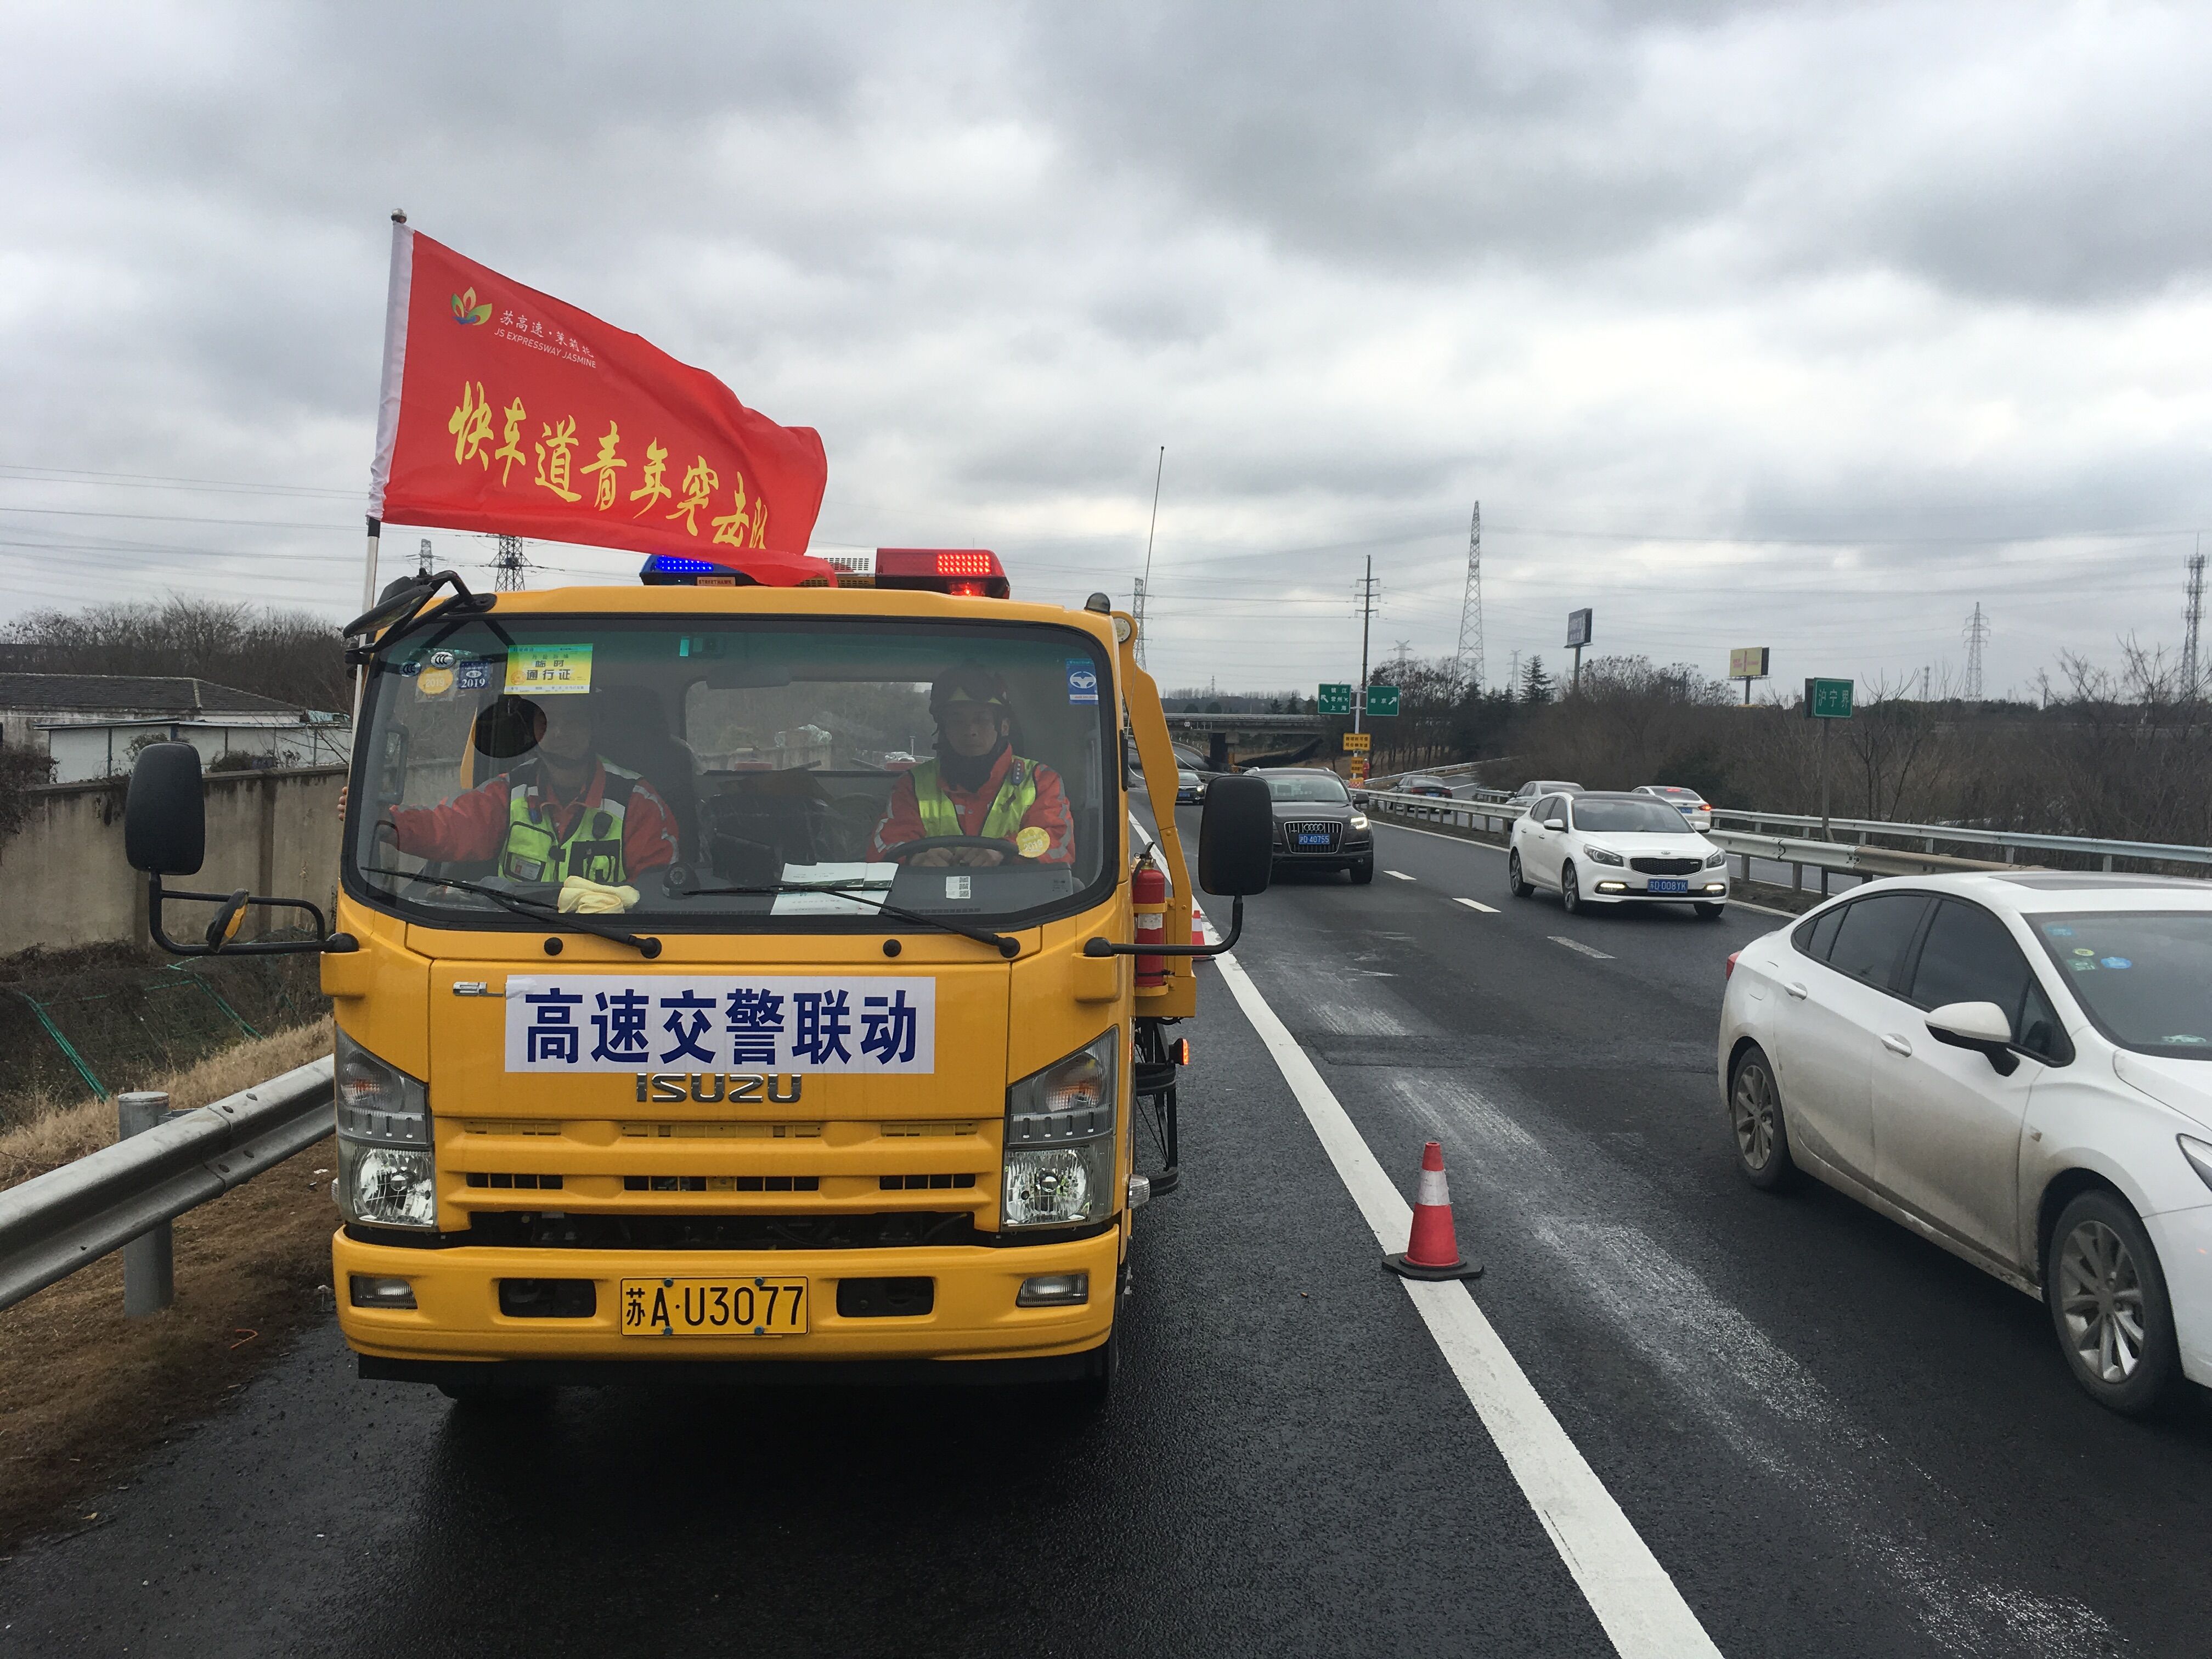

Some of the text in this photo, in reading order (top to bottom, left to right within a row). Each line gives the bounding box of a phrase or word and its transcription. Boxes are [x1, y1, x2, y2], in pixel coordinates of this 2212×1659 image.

[494, 328, 597, 369] JS EXPRESSWAY JASMINE
[426, 678, 445, 687] 2019
[461, 678, 486, 688] 2019
[526, 669, 571, 681] 通行证
[1818, 688, 1849, 709] 沪宁界
[525, 988, 917, 1065] 高速交警联动
[635, 1073, 803, 1103] ISUZU
